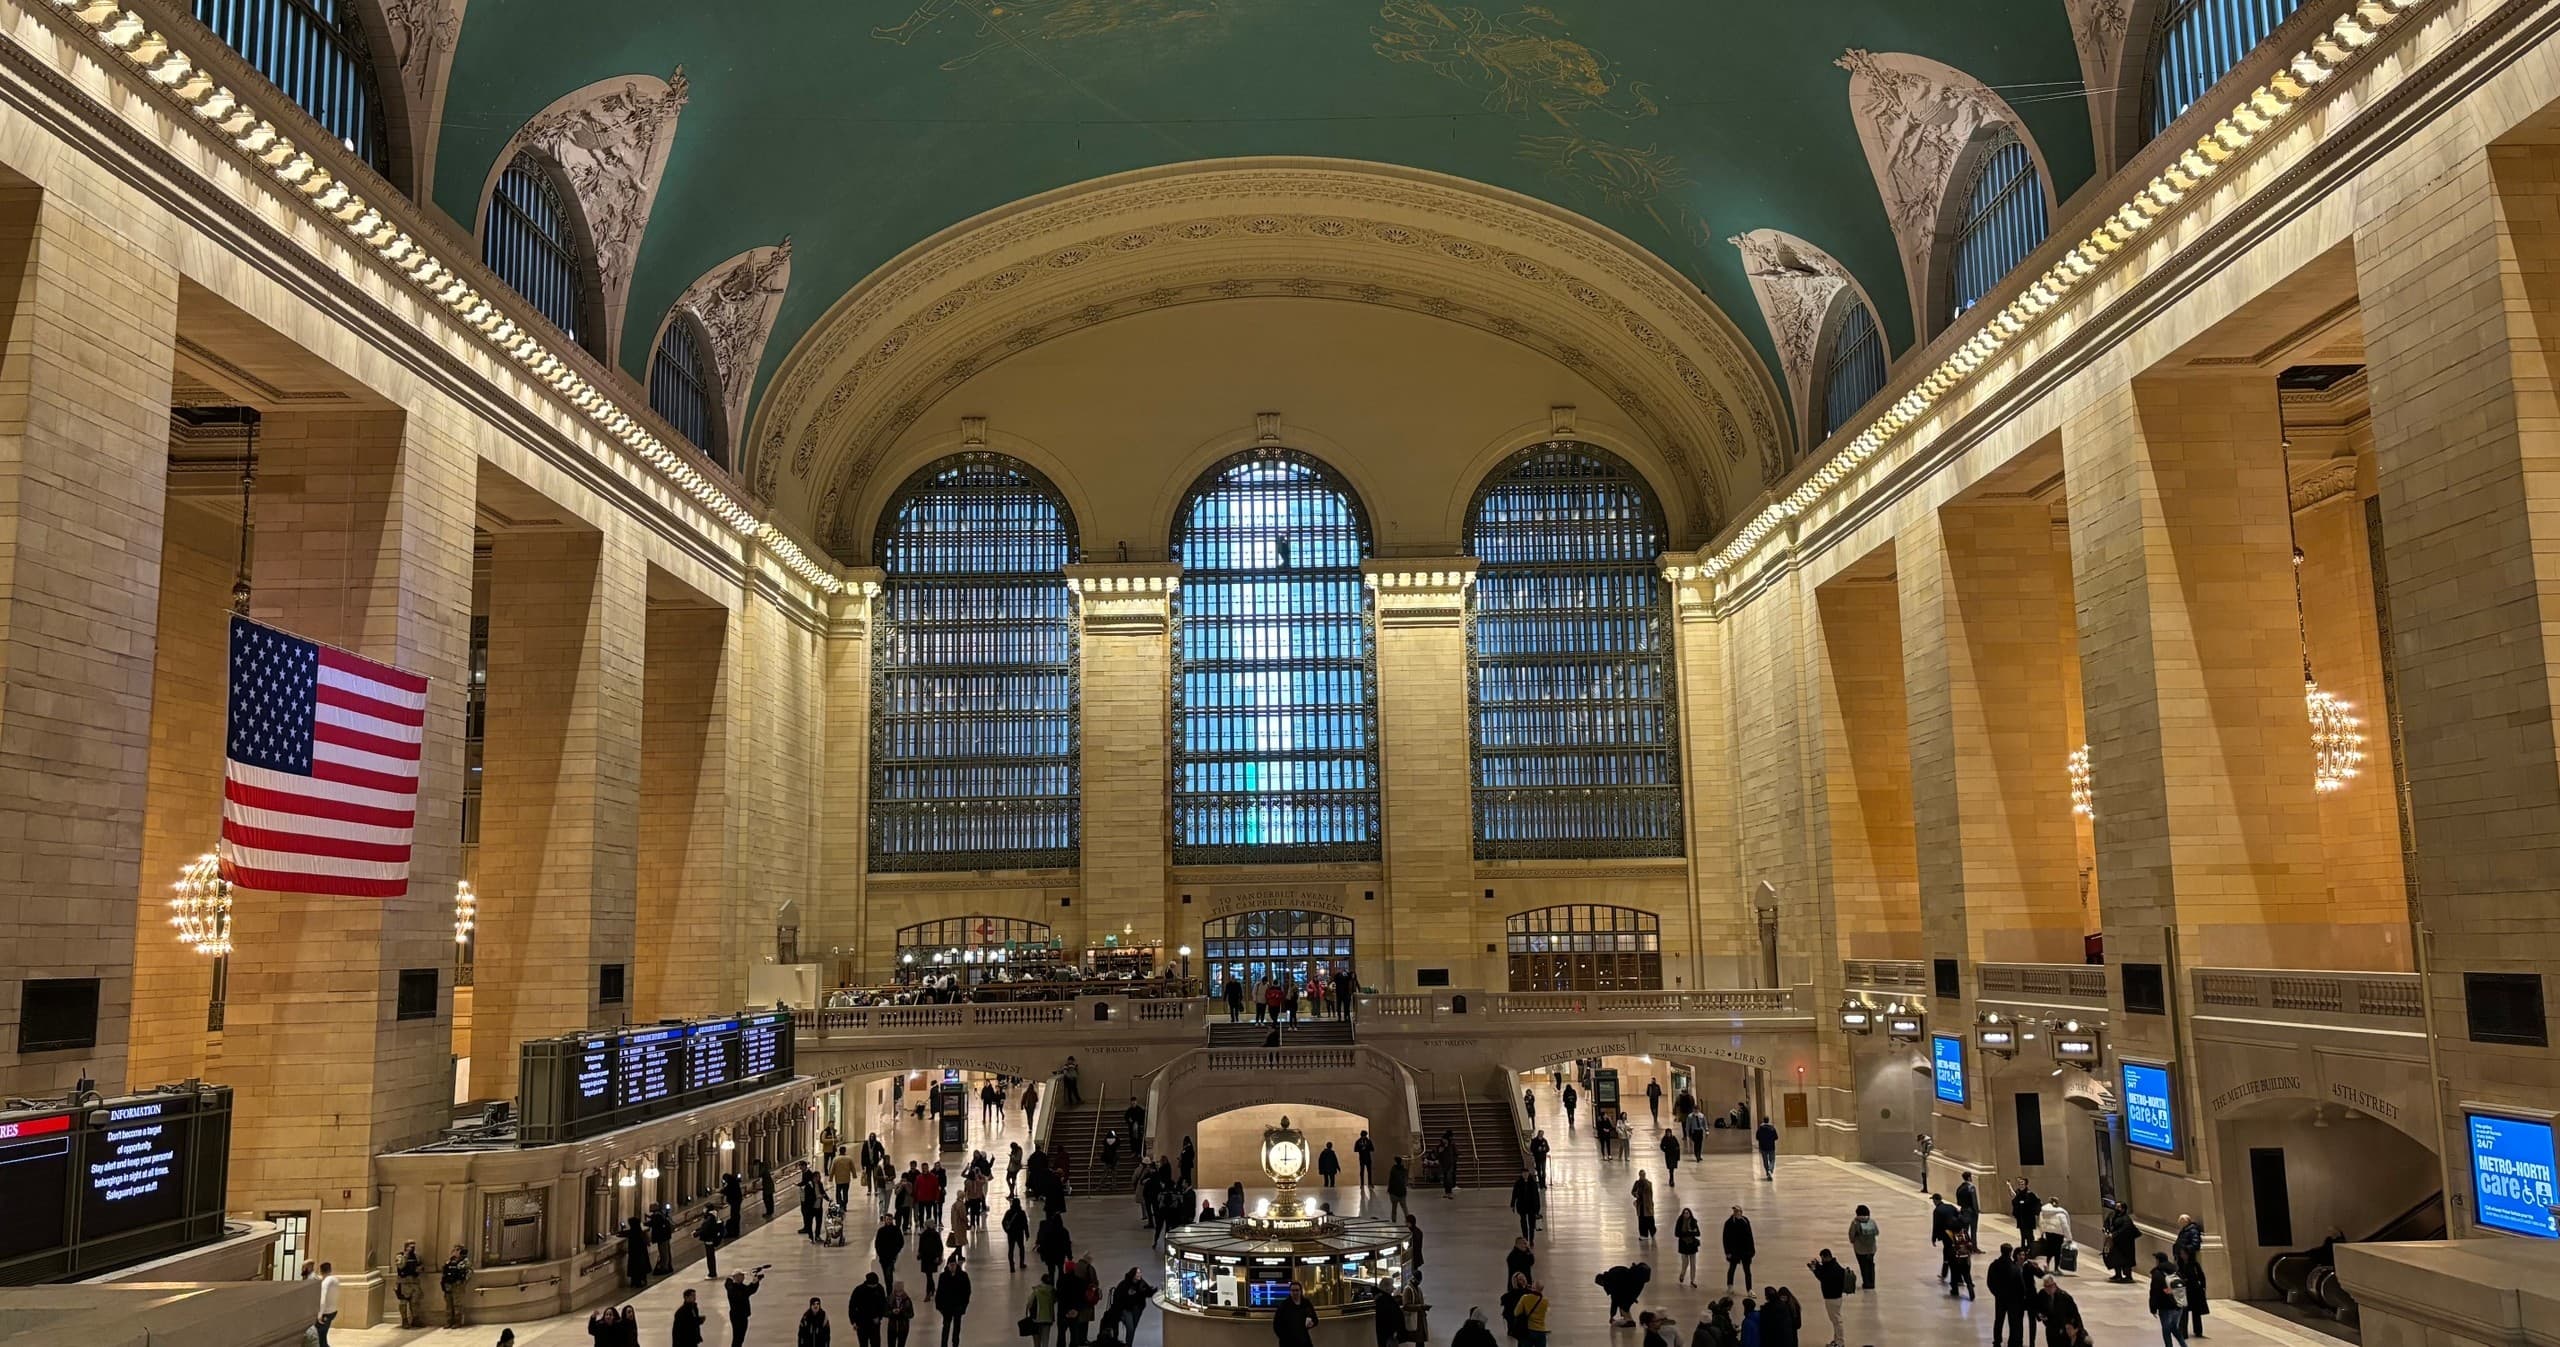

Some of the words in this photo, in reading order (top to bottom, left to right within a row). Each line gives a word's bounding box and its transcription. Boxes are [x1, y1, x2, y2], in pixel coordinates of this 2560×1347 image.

[1236, 890, 1295, 901] VANDERBILT
[1301, 890, 1338, 903] AVENUE
[1212, 904, 1232, 915] THE
[1236, 899, 1284, 910] CAMPBELL
[1289, 899, 1345, 913] APARTMENT
[1540, 1049, 1573, 1062] TICKET
[1576, 1043, 1626, 1056] MACHINES
[1658, 1043, 1696, 1053] TRACKS
[1714, 1048, 1726, 1057] 42
[1734, 1051, 1755, 1064] LIRR
[850, 1058, 904, 1072] MACHINES
[937, 1057, 976, 1067] SUBWAY
[982, 1061, 1008, 1072] 42ND
[1009, 1064, 1024, 1074] ST
[2211, 1093, 2227, 1112] THE
[2227, 1081, 2260, 1103] METLIFE
[2260, 1075, 2300, 1093] BUILDING
[2332, 1082, 2357, 1102] 45TH
[2360, 1091, 2400, 1120] STREET
[110, 1103, 162, 1121] INFORMATION
[2129, 1104, 2151, 1123] care
[107, 1130, 122, 1142] Don't
[122, 1128, 142, 1140] become
[147, 1124, 162, 1136] target
[117, 1144, 123, 1155] of
[2477, 1138, 2493, 1150] 24/7
[90, 1163, 104, 1174] Stay
[104, 1161, 117, 1172] alert
[116, 1158, 127, 1169] and
[127, 1157, 140, 1167] keep
[140, 1155, 152, 1166] your
[151, 1150, 174, 1164] personal
[2478, 1155, 2551, 1182] METRO-NORTH
[94, 1175, 123, 1188] belongings
[129, 1170, 142, 1182] sight
[2480, 1172, 2521, 1200] care
[105, 1186, 133, 1200] Safeguard
[133, 1185, 144, 1196] your
[1273, 1219, 1313, 1229] Information
